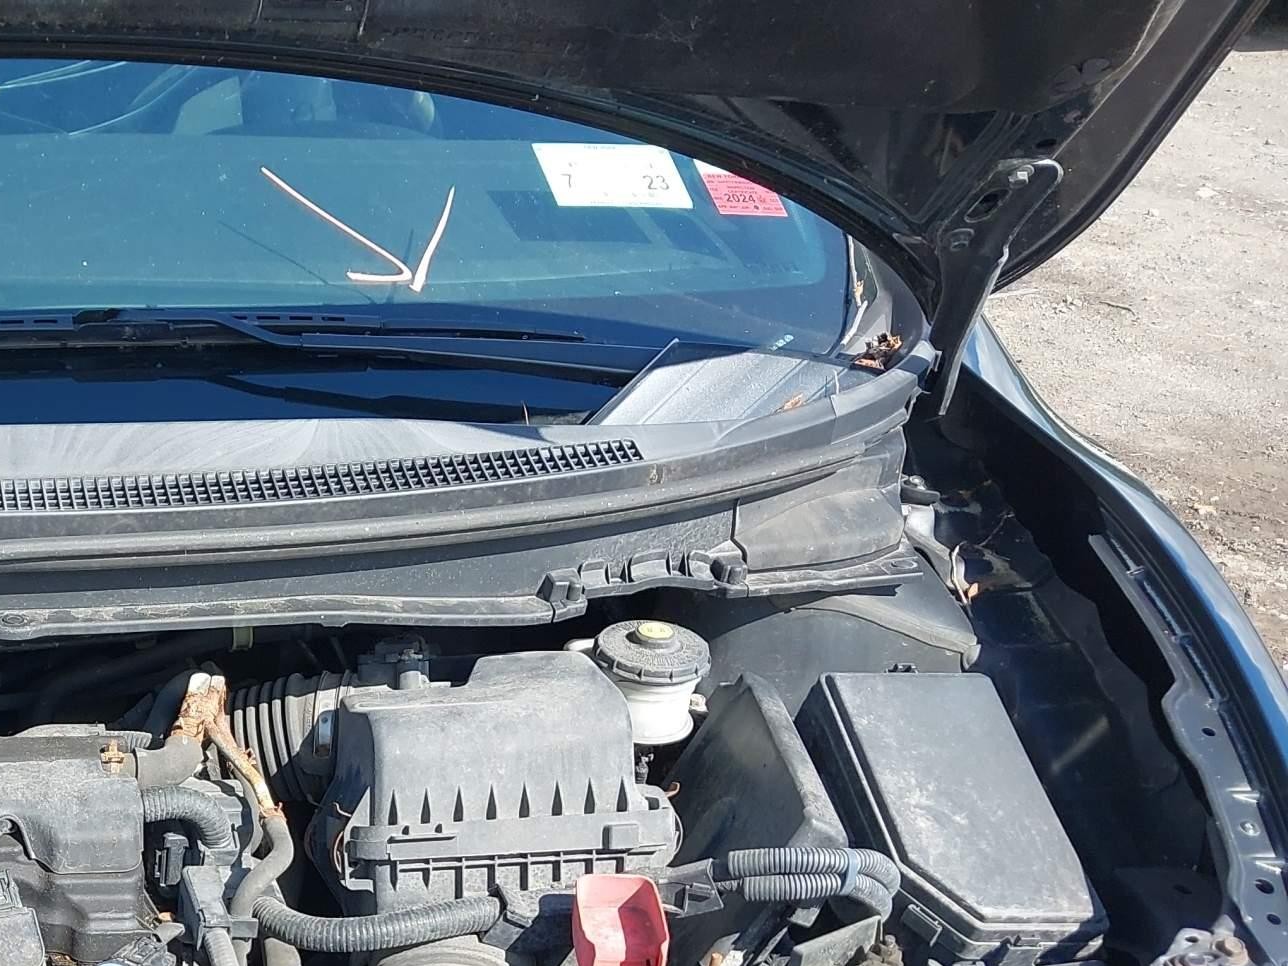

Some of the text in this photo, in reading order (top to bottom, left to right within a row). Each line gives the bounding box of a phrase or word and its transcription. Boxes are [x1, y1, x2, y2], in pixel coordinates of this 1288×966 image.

[560, 173, 670, 190] 7 23
[724, 193, 755, 203] 2024
